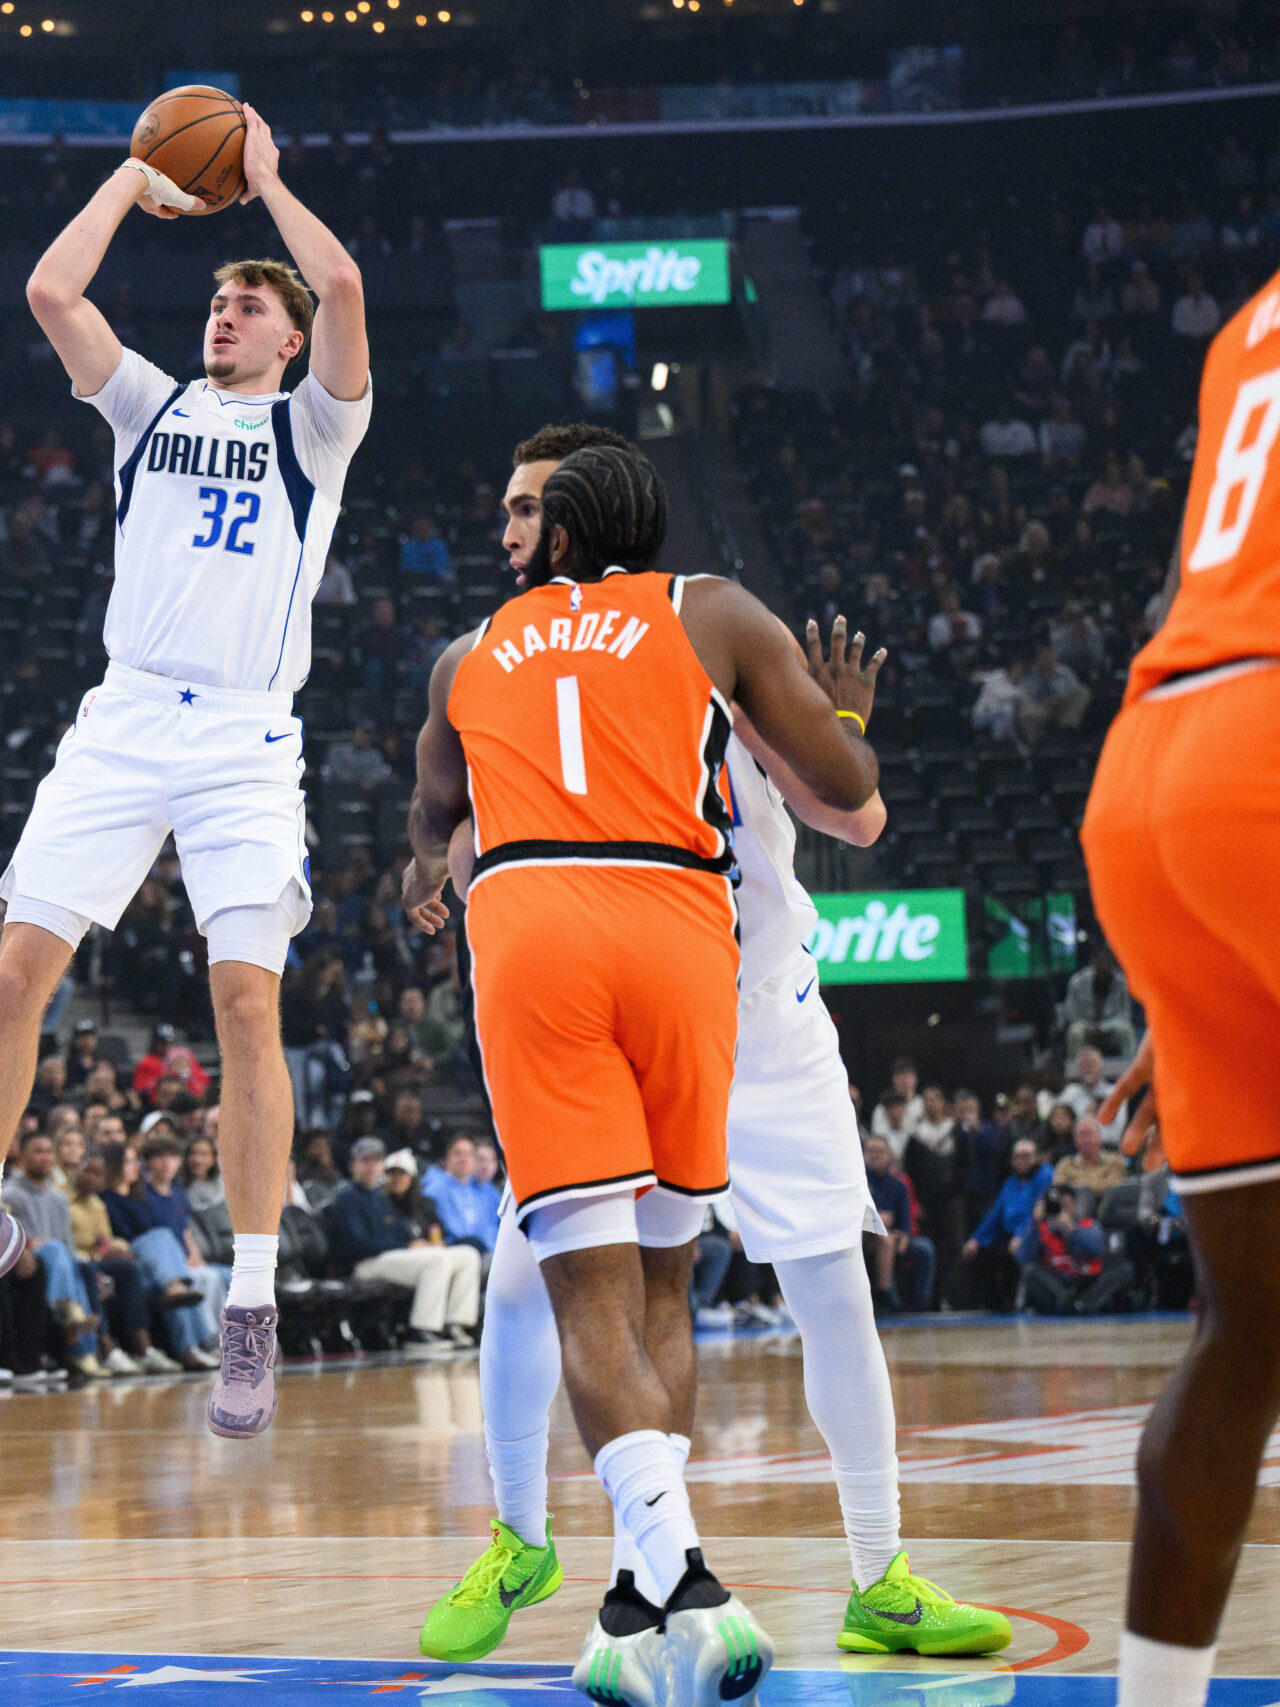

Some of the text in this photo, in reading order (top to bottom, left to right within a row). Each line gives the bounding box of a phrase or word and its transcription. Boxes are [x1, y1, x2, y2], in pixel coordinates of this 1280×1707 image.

[570, 247, 701, 304] Sprite
[146, 432, 270, 482] DALLAS
[191, 486, 261, 556] 32
[492, 610, 650, 674] HARDEN
[556, 675, 588, 795] 1
[802, 900, 941, 963] prite
